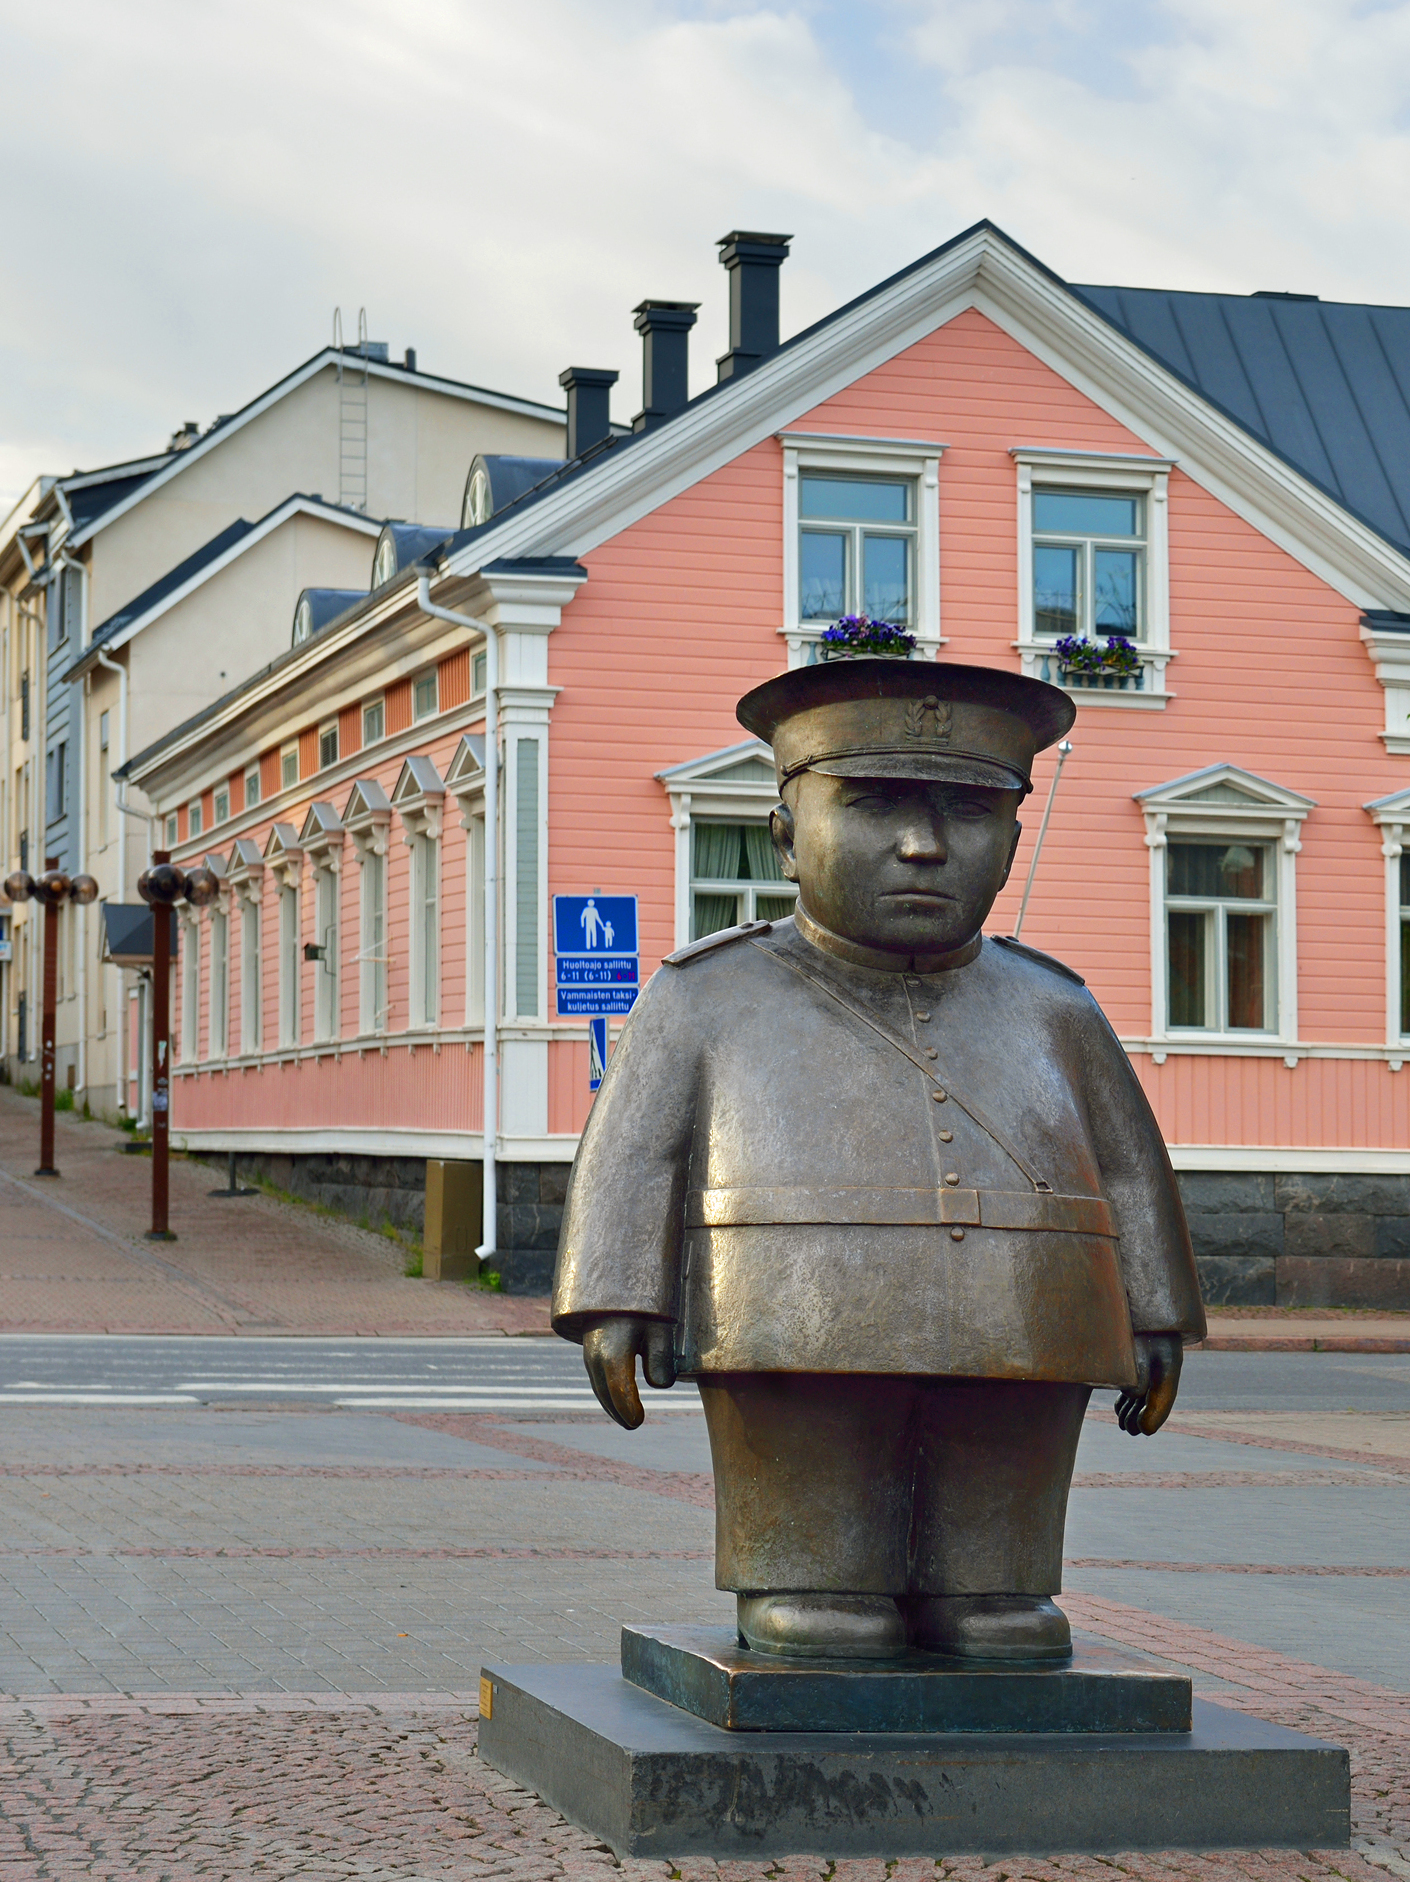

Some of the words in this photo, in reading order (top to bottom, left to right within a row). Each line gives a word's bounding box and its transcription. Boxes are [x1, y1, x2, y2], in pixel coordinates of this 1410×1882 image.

[562, 960, 602, 971] Huoltoajo
[603, 960, 632, 970] sallittu
[560, 990, 611, 1000] Vammaisten
[612, 990, 636, 1000] taksi-
[567, 1001, 600, 1012] kuljetus
[601, 1001, 630, 1011] sallittu
